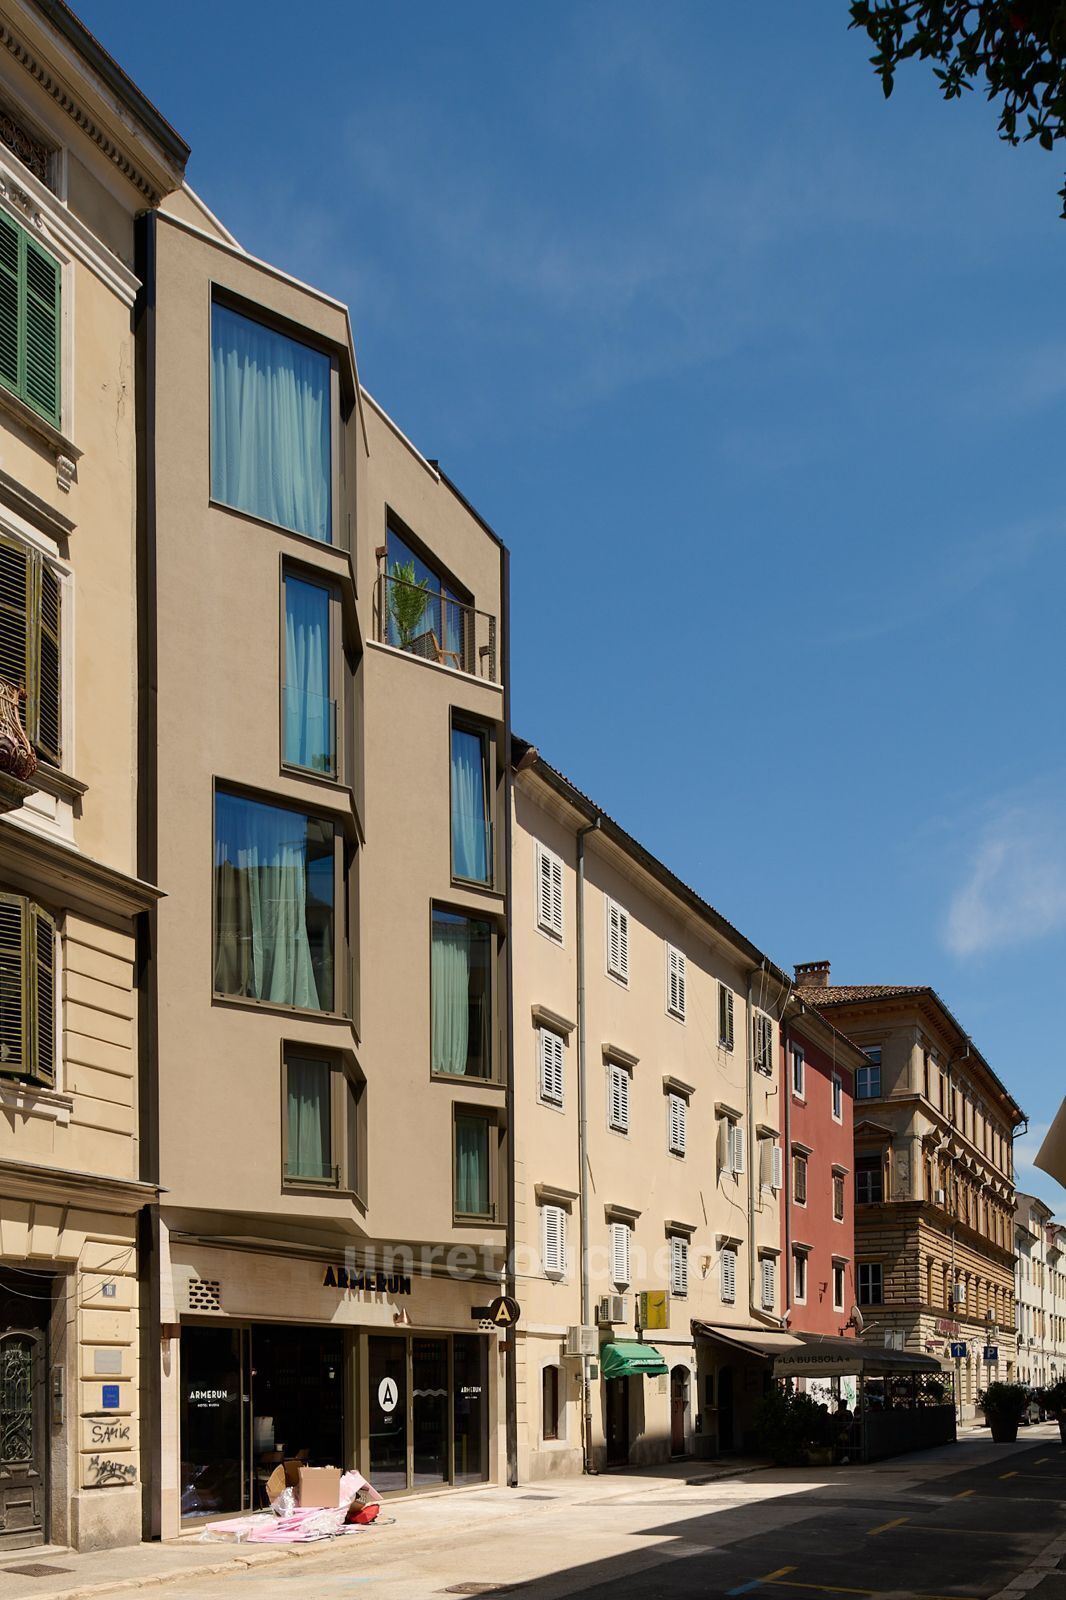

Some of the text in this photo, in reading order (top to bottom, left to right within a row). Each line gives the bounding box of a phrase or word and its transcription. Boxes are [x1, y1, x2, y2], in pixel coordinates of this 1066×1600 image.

[323, 1264, 412, 1295] ARMERUN
[494, 1300, 512, 1322] A
[987, 1348, 995, 1358] P
[190, 1390, 228, 1399] ARMERUN
[382, 1382, 394, 1405] A
